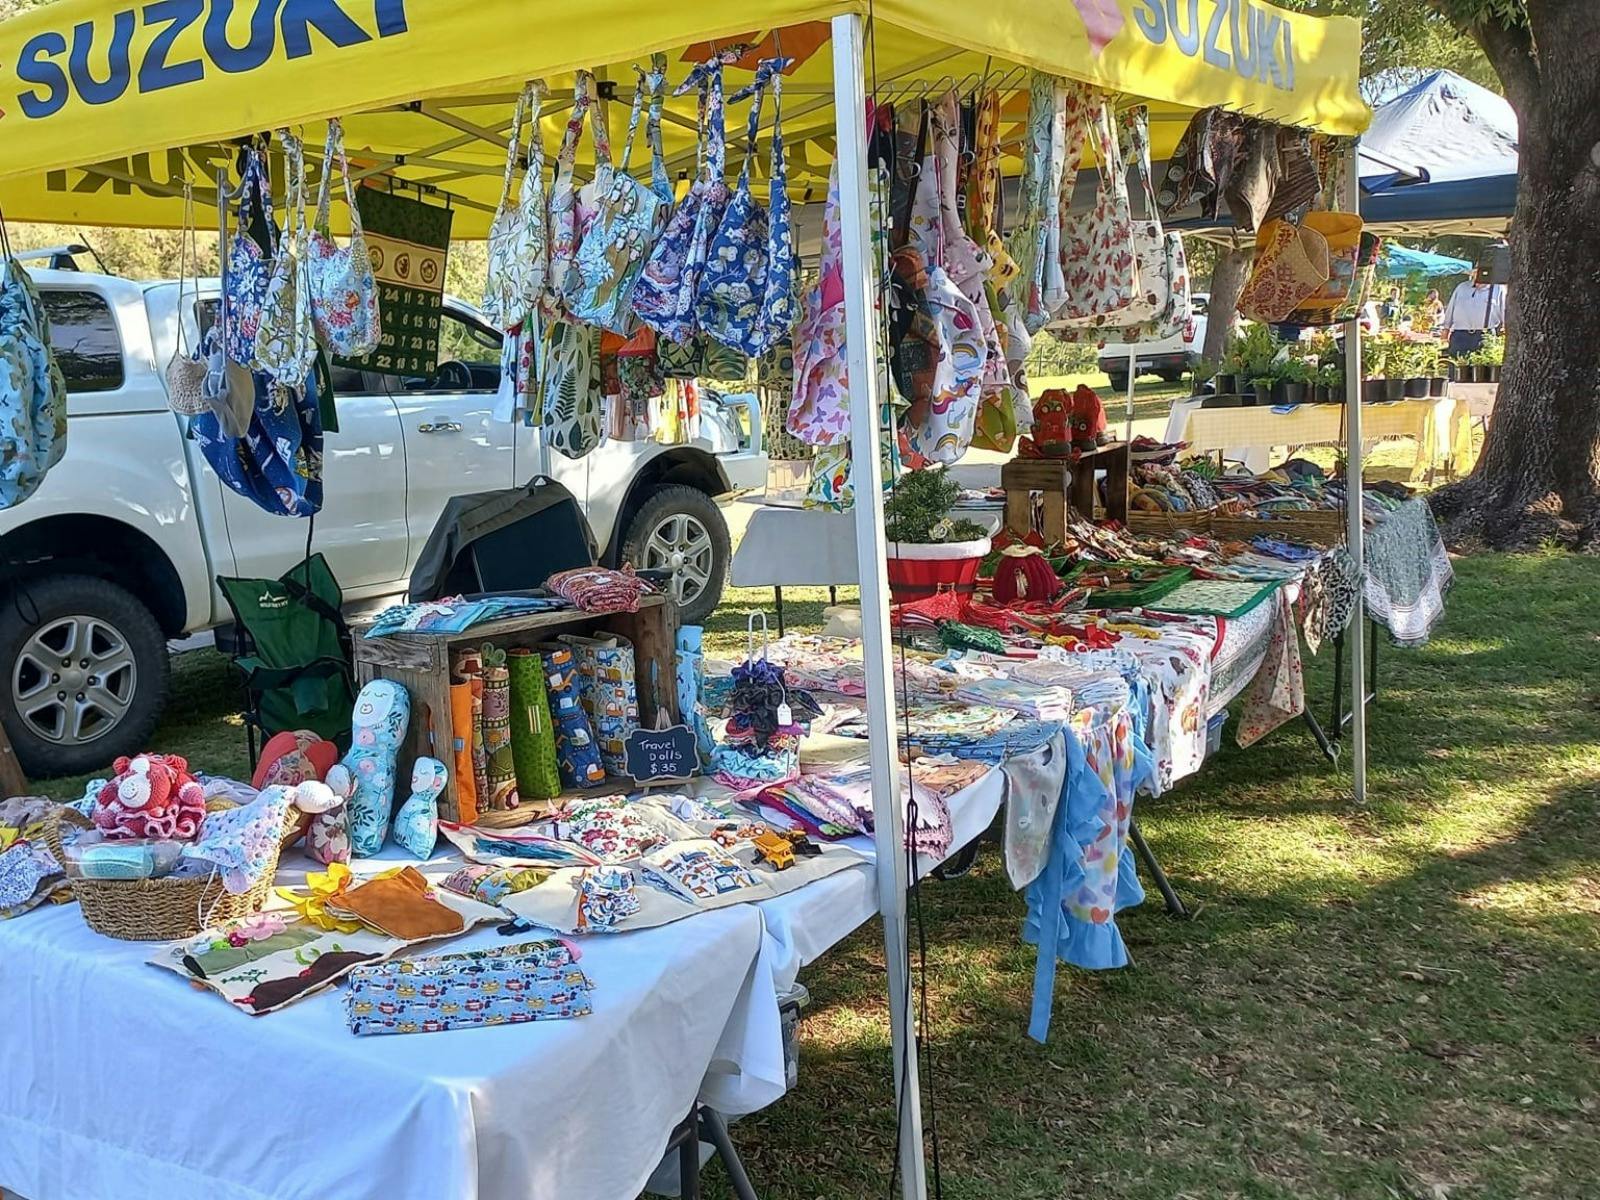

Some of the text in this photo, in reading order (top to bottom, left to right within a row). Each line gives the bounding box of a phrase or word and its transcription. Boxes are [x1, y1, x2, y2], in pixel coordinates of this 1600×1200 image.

[384, 288, 400, 302] 24
[417, 294, 424, 306] 2
[386, 311, 392, 324] 4
[428, 316, 438, 330] 10
[381, 333, 395, 346] 20
[426, 339, 436, 352] 12
[376, 355, 391, 369] 22
[412, 358, 418, 370] 3
[638, 737, 676, 751] Travel
[649, 749, 683, 761] Dolls
